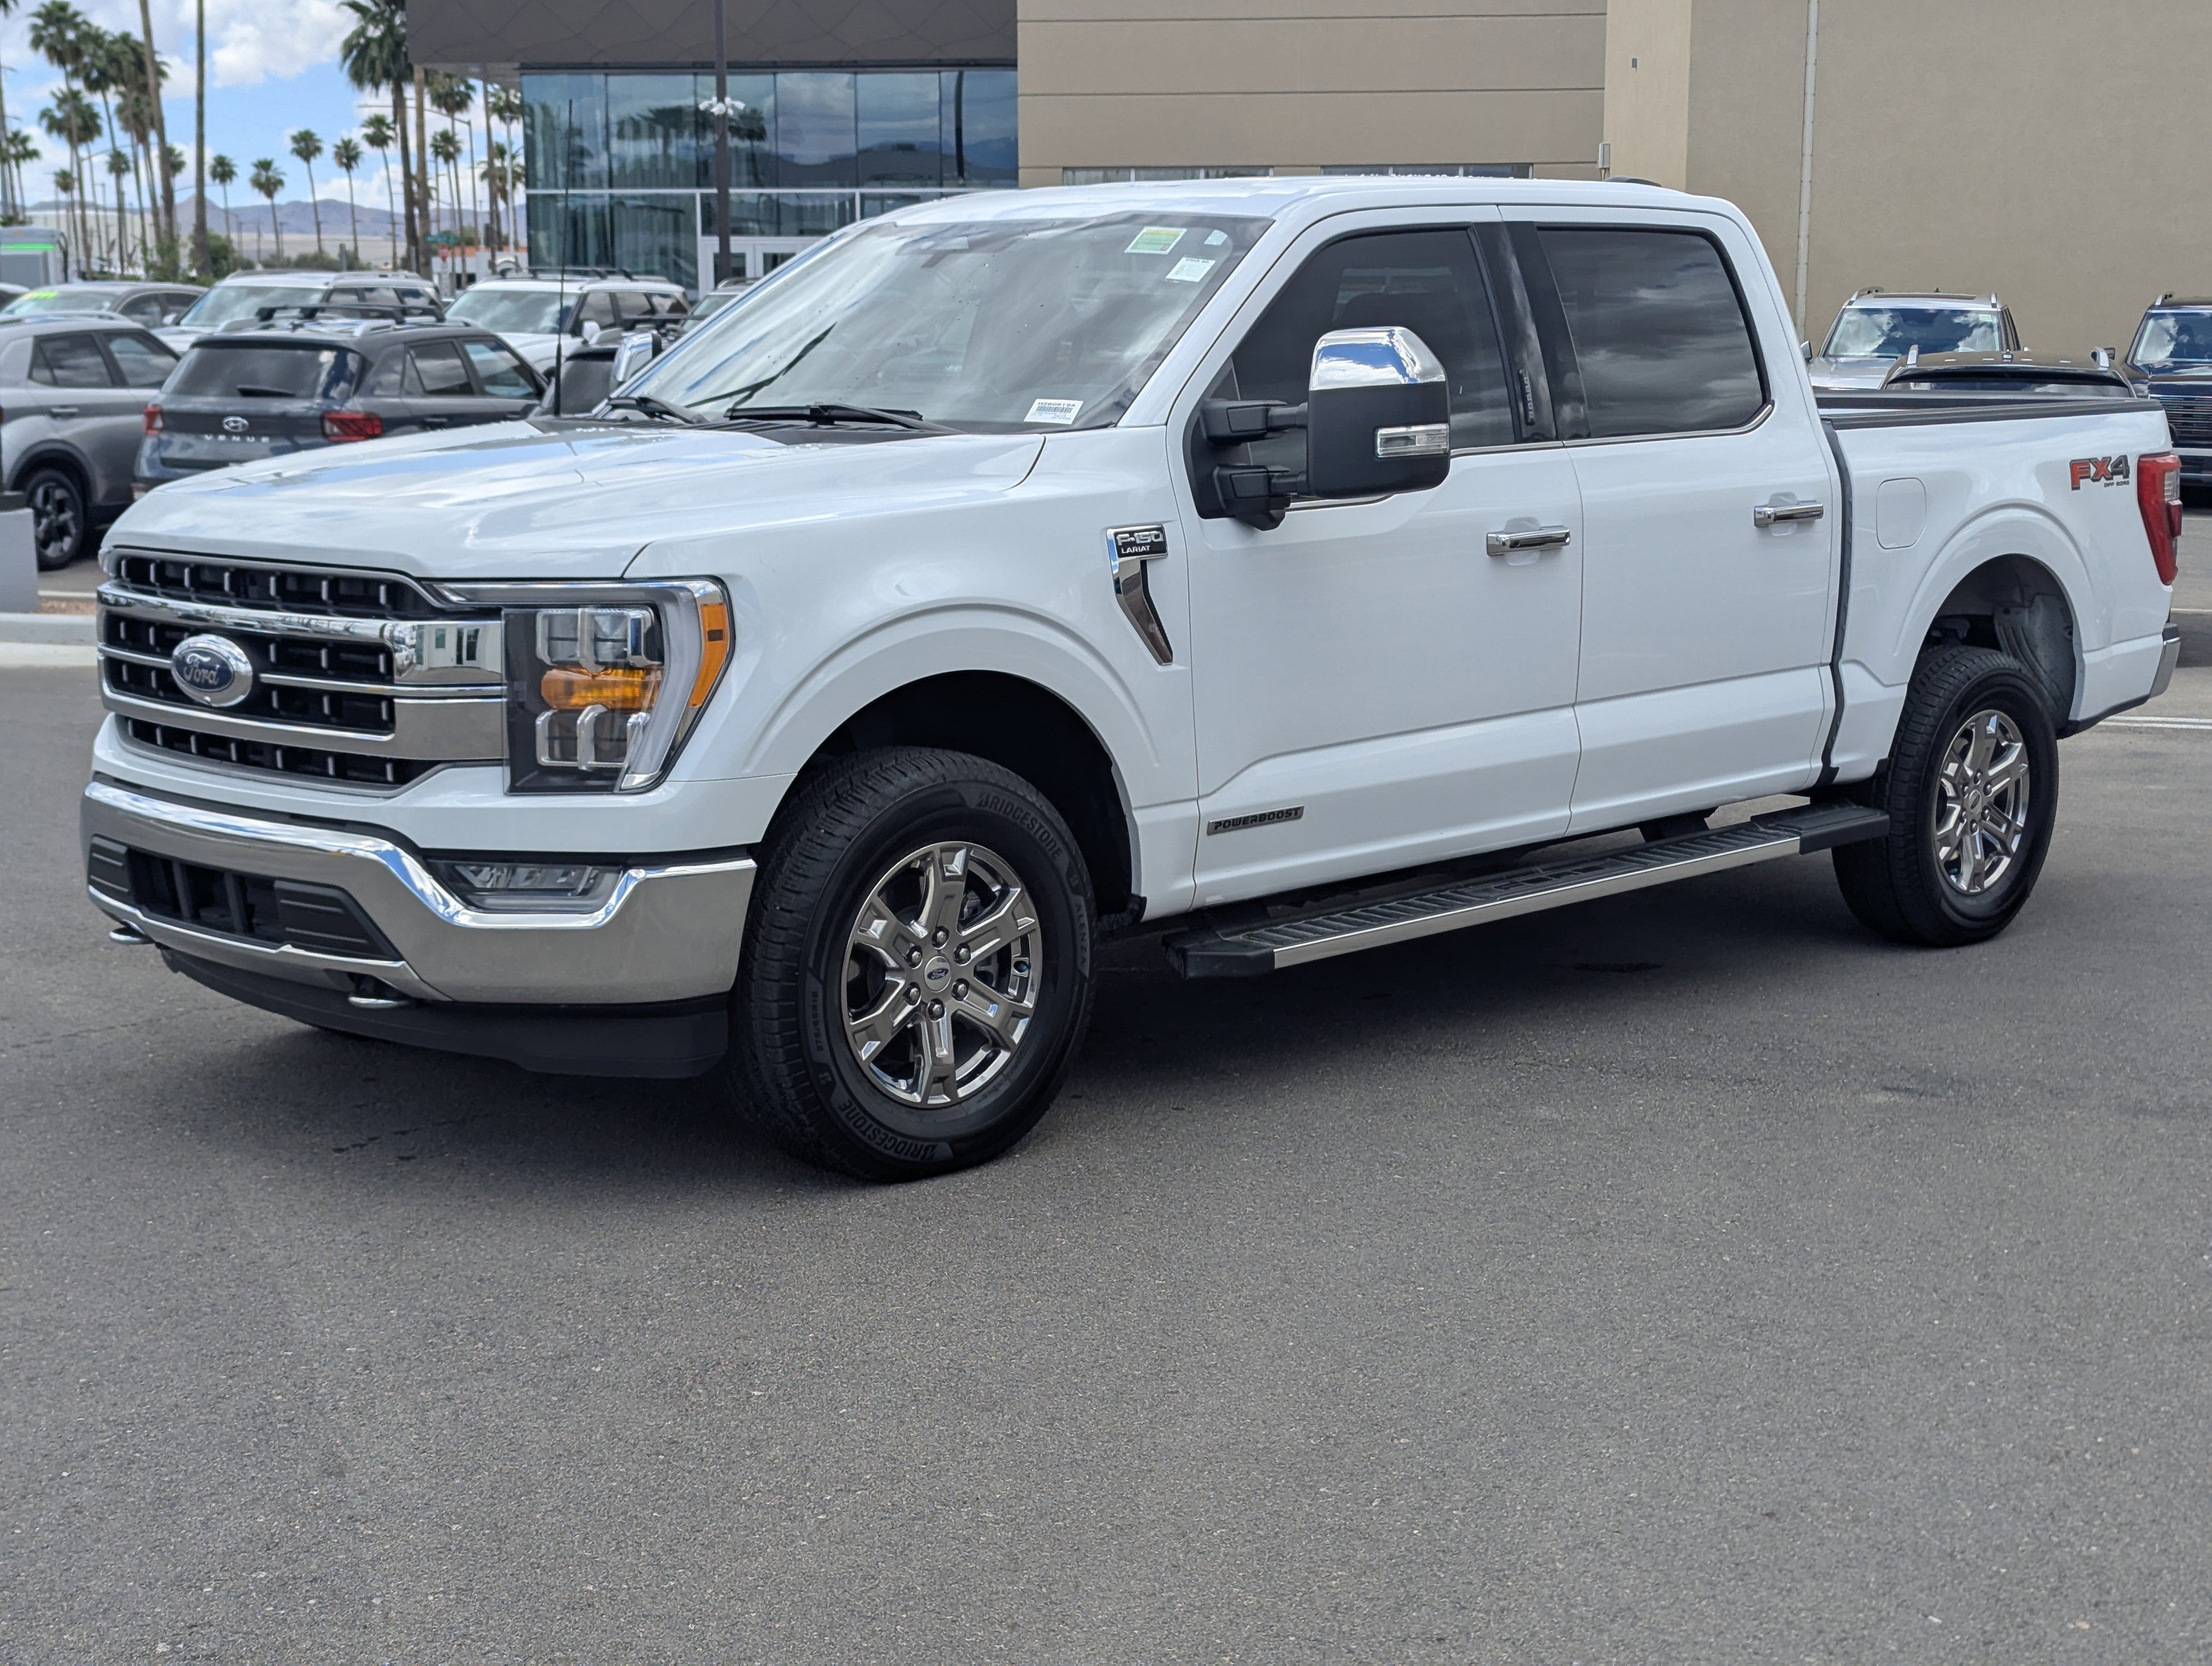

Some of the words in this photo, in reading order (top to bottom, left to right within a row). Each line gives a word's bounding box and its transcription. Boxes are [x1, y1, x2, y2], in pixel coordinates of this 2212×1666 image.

[204, 434, 271, 443] VENUE
[2069, 454, 2130, 491] FX4
[1116, 531, 1165, 546] F-150
[1121, 545, 1150, 554] LARIAT
[183, 652, 220, 685] Ford
[977, 792, 1064, 858] BRIDGESTONE
[1214, 808, 1300, 830] POWERBOOST
[931, 969, 946, 979] Ford
[840, 1097, 938, 1161] BRIDGESTONE
